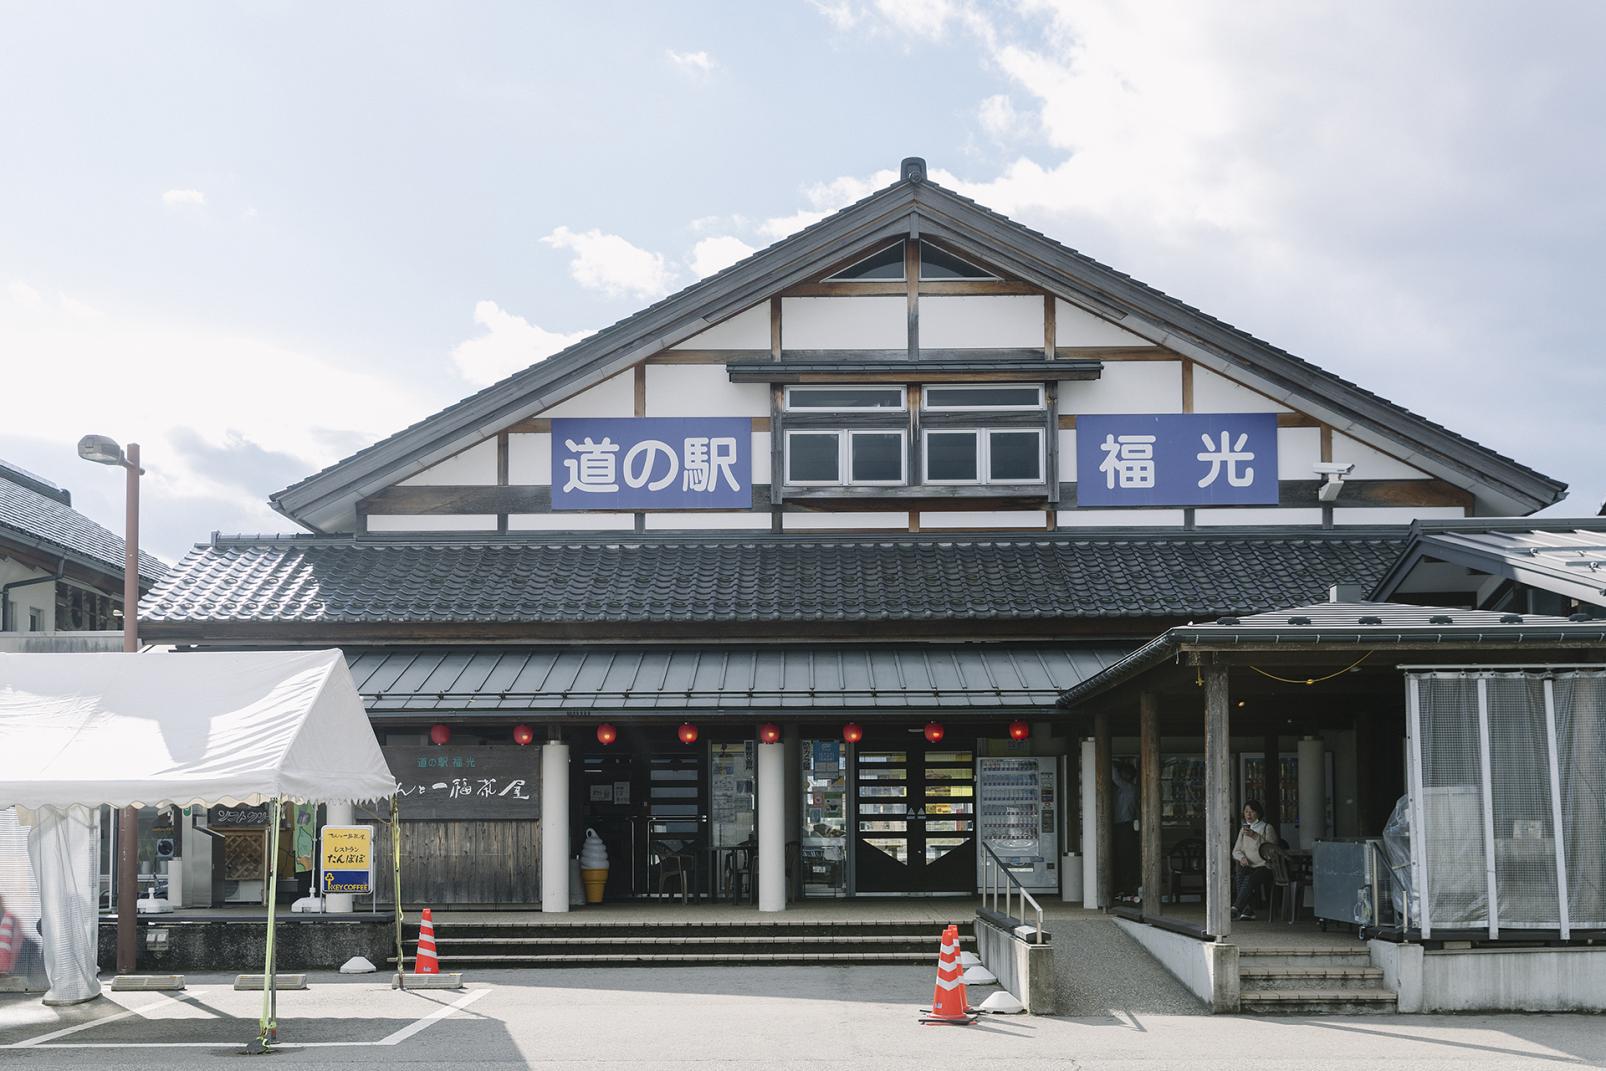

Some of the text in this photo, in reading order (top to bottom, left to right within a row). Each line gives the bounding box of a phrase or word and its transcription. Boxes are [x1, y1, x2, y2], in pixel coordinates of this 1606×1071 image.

[563, 436, 741, 493] 道の駅
[396, 778, 530, 799] んと一福茶屋
